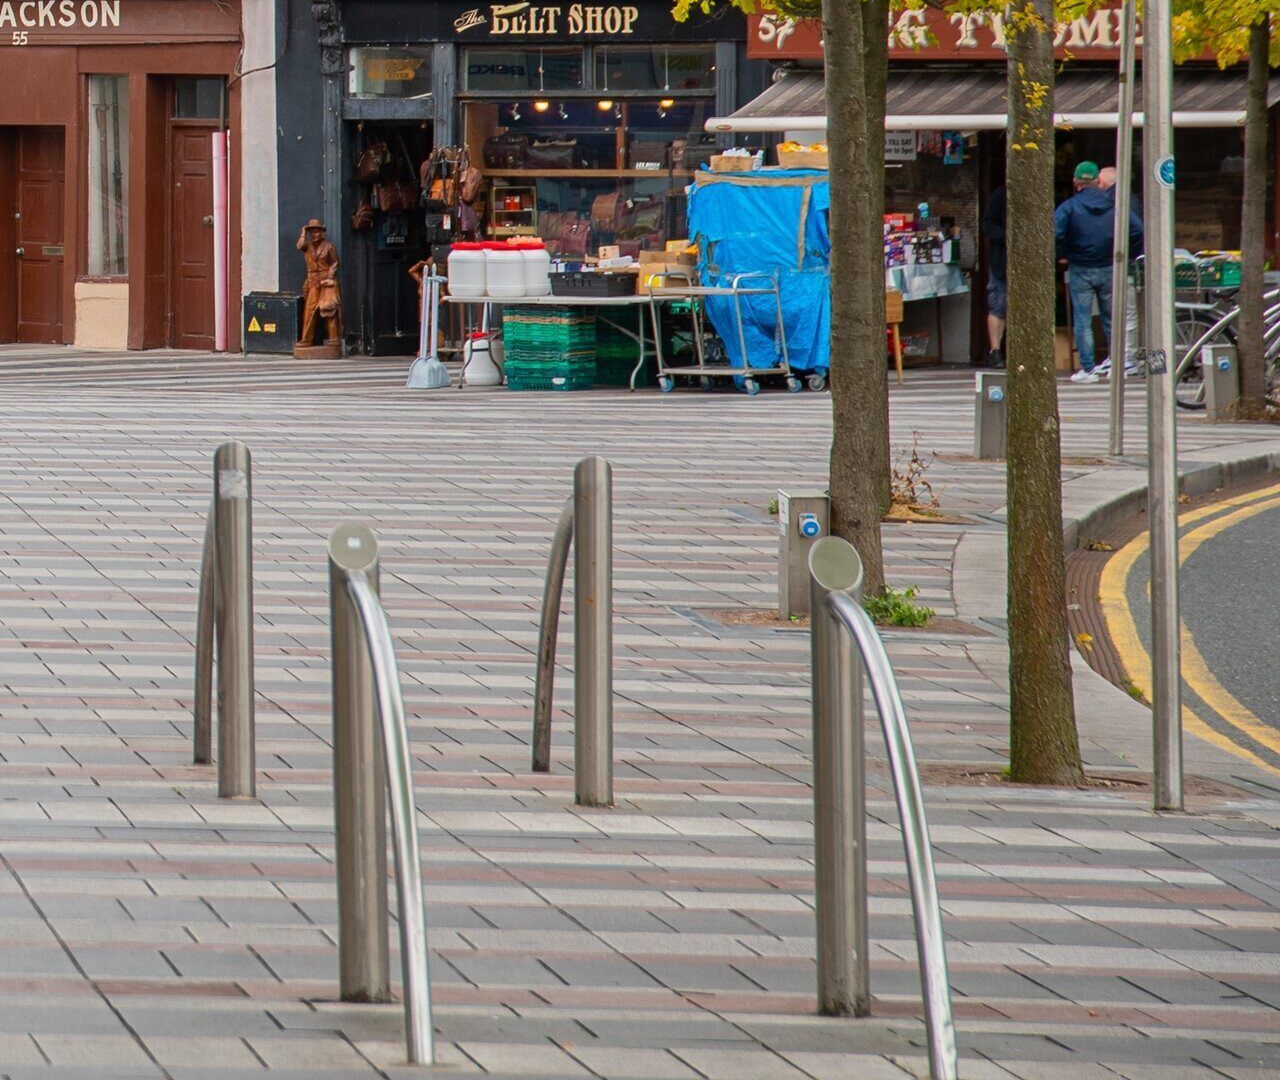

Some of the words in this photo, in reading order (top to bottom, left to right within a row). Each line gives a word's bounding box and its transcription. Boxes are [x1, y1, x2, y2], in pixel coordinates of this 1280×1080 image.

[454, 9, 488, 32] The
[490, 4, 561, 35] BELT
[568, 3, 639, 35] SHOP
[758, 13, 795, 48] 57
[12, 31, 29, 46] 55
